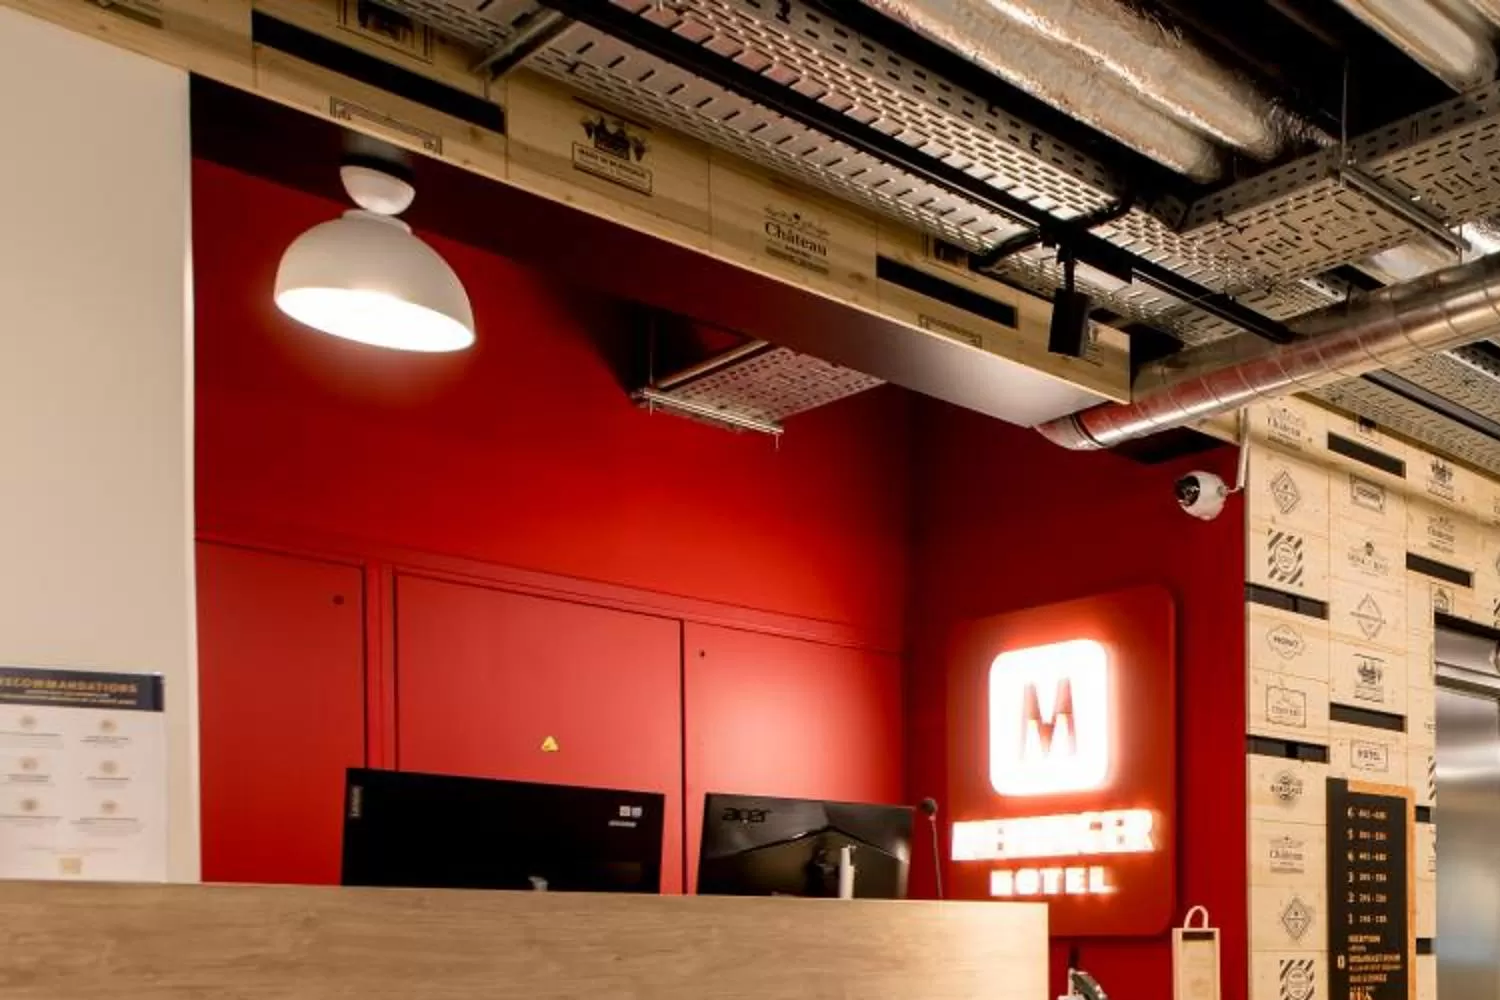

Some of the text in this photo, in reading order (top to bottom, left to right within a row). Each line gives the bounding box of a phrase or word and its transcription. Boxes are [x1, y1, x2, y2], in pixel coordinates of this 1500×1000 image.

[765, 221, 828, 257] Château
[1021, 677, 1077, 762] M
[721, 807, 774, 823] acer
